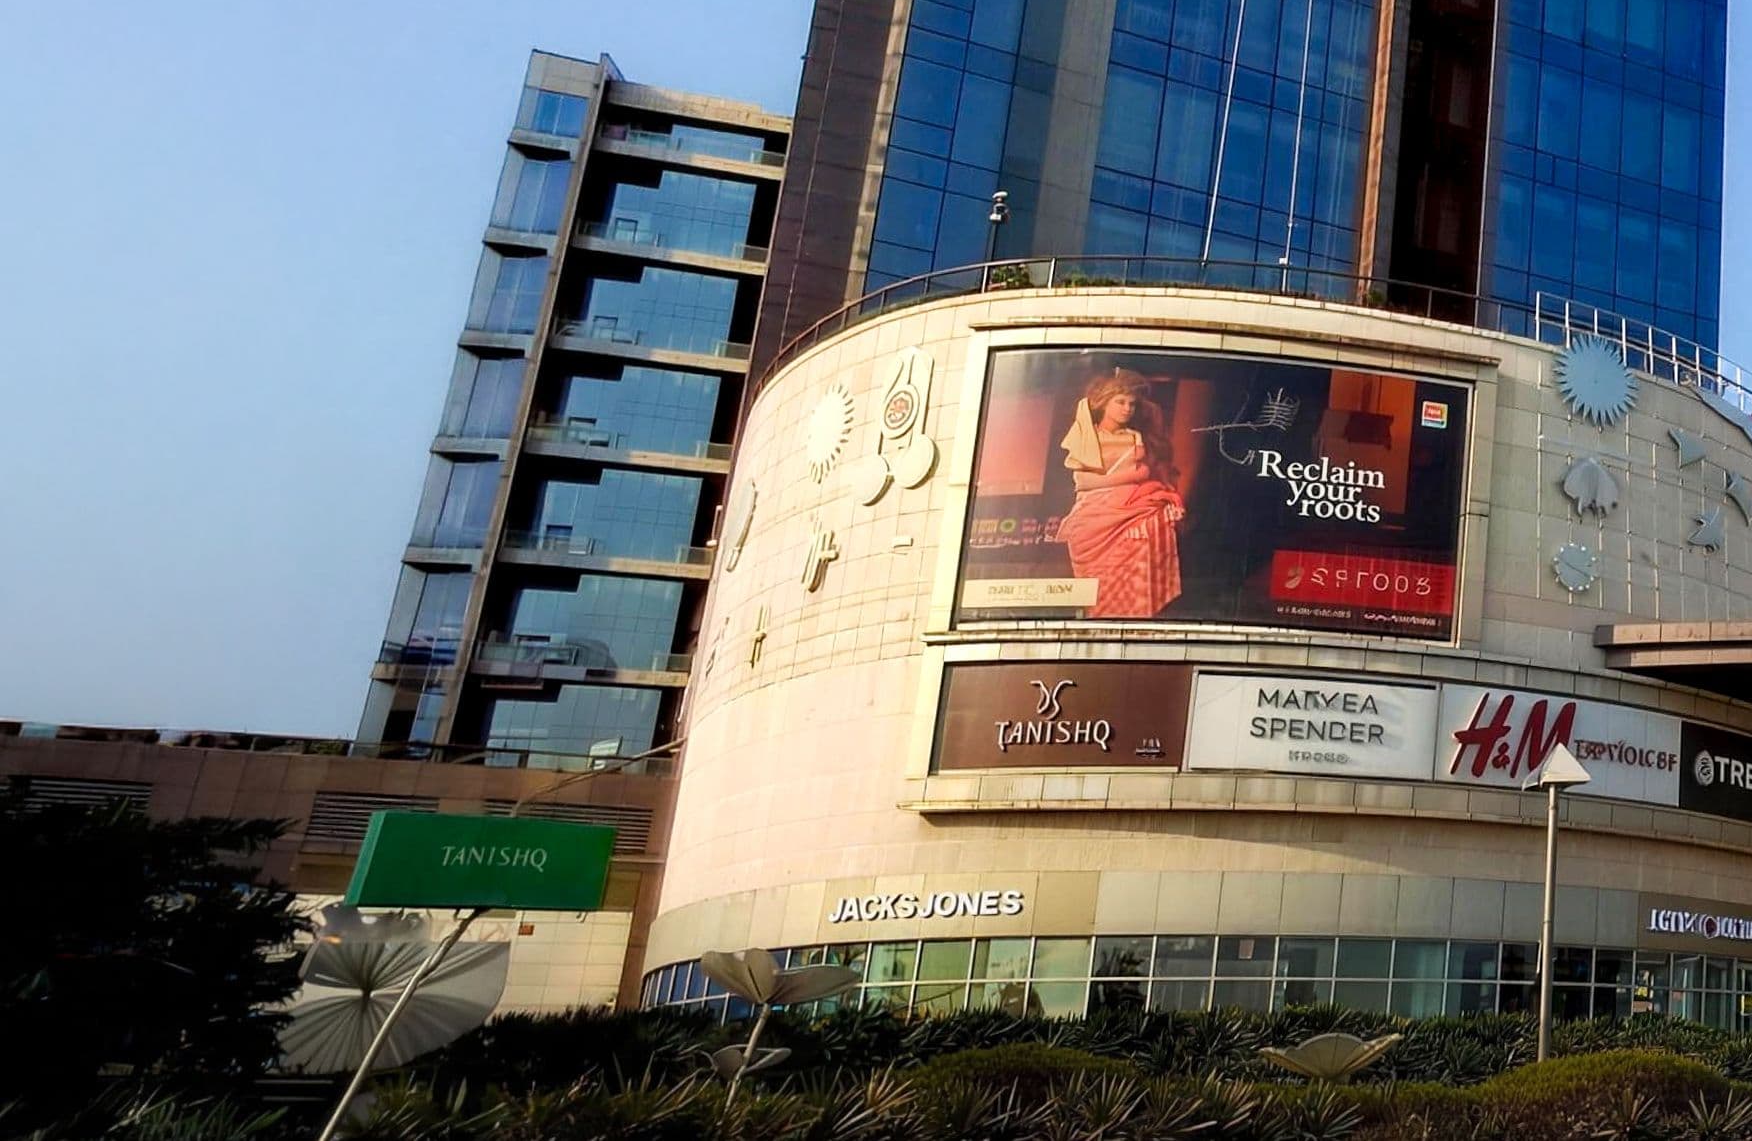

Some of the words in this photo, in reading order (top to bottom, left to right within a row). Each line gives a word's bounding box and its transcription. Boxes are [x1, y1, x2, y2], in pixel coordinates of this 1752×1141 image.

[1257, 449, 1385, 489] Reclaim
[1286, 479, 1362, 506] your
[1298, 499, 1382, 523] roots
[994, 719, 1111, 751] TANISHQ
[1449, 691, 1577, 779] H&M
[440, 844, 548, 873] TANISHQ
[919, 890, 1025, 919] JONES
